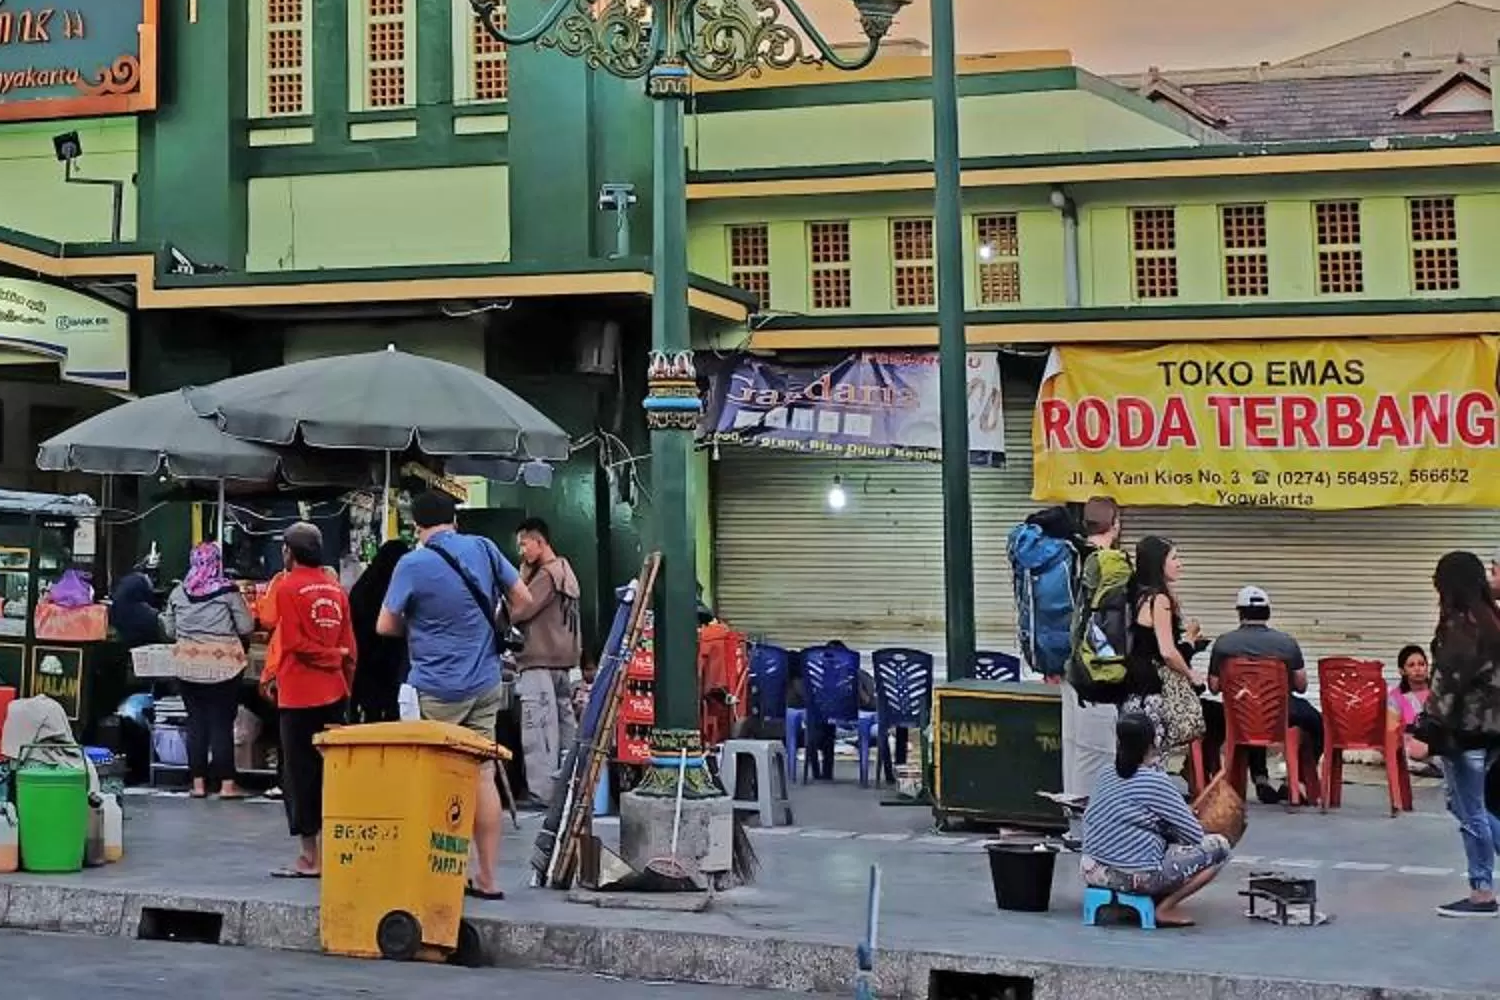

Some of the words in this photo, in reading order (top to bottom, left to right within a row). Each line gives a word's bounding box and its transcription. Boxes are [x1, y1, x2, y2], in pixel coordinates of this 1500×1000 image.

[1157, 360, 1254, 387] TOKO
[1266, 359, 1366, 386] EMAS
[1041, 395, 1197, 450] RODA
[1207, 391, 1498, 448] TERBANG
[1067, 470, 1087, 485] Jl.
[1093, 470, 1109, 486] A.
[1113, 470, 1149, 485] Yani
[1155, 469, 1193, 485] Kios
[1198, 469, 1228, 485] No.
[1231, 470, 1241, 484] 3
[1277, 470, 1331, 488] (0274)
[1337, 470, 1403, 486] 564952,
[1216, 490, 1314, 506] Yogyakarta
[940, 721, 997, 747] SIANG
